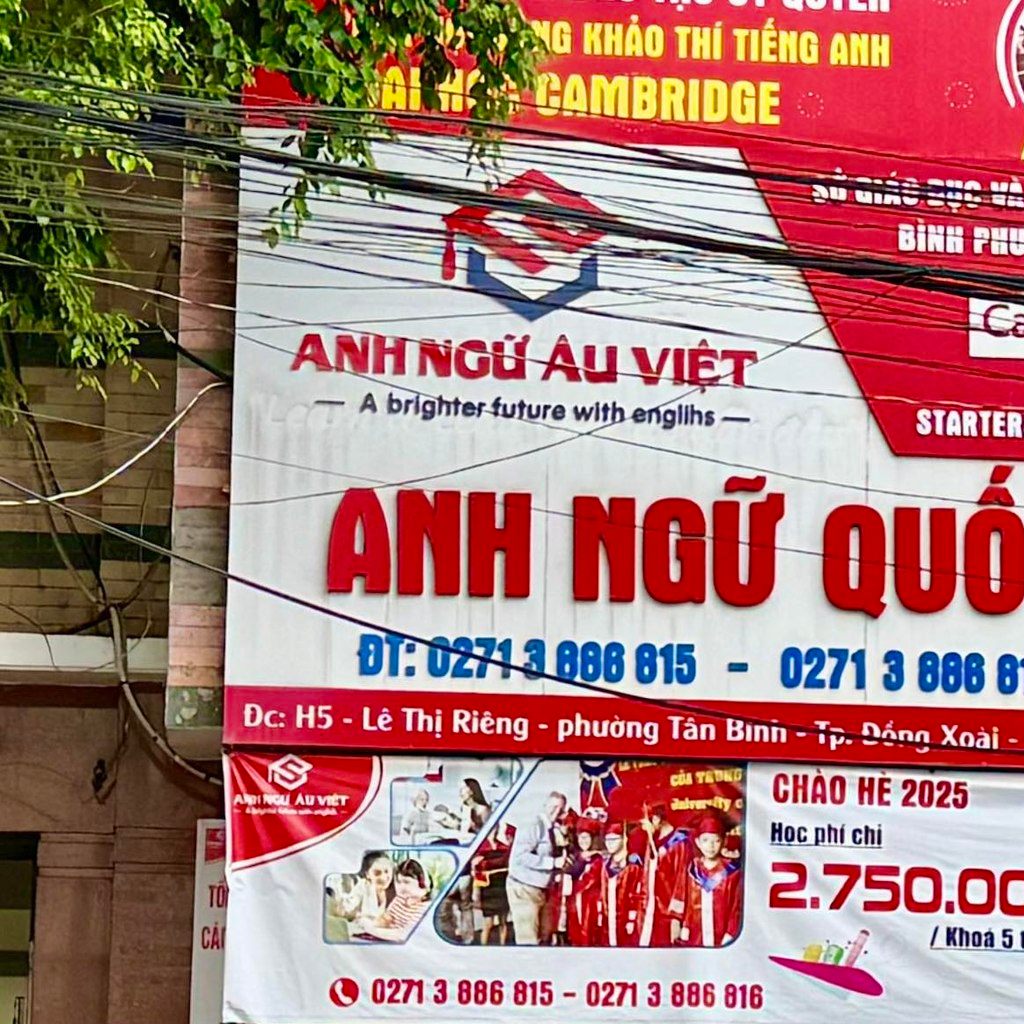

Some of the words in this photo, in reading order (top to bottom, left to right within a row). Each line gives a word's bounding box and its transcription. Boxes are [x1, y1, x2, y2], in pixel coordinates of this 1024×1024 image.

[583, 15, 664, 58] KHẢO
[674, 21, 723, 60] THÍ
[733, 17, 819, 64] TIẾNG
[829, 33, 890, 67] ANH
[535, 72, 780, 125] CAMBRIDGE
[898, 218, 964, 253] BÌNH
[291, 333, 407, 375] ANH
[419, 335, 530, 379] NGỮ
[542, 334, 618, 384] ÂU
[631, 339, 758, 393] VIỆT
[359, 394, 377, 413] A
[387, 396, 484, 421] brighter
[492, 398, 566, 420] future
[573, 402, 625, 422] with
[327, 488, 532, 598] ANH
[573, 475, 785, 608] NGỮ
[358, 633, 416, 677] ĐT:
[427, 635, 511, 680] 0271
[523, 639, 546, 681] 3
[635, 642, 697, 685] 815
[780, 647, 866, 690] 0271
[883, 650, 905, 692] 3
[243, 703, 286, 728] Đc:
[296, 705, 333, 730] H5
[363, 706, 393, 731] Lê
[401, 708, 442, 738] Thị
[453, 709, 529, 741] Riêng
[558, 714, 659, 746] phường
[669, 714, 716, 741] Tân
[941, 724, 999, 751] Xoài
[773, 769, 846, 805] CHÀO
[858, 771, 892, 807] HÈ
[902, 778, 969, 809] 2025
[814, 823, 845, 847] phí
[1001, 929, 1013, 950] 5
[371, 978, 424, 1005] 0271
[433, 980, 448, 1006] 3
[456, 980, 504, 1006] 886
[514, 980, 554, 1007] 815
[585, 981, 639, 1008] 0271
[646, 982, 661, 1008] 3
[670, 982, 716, 1009] 886
[724, 983, 763, 1010] 816
